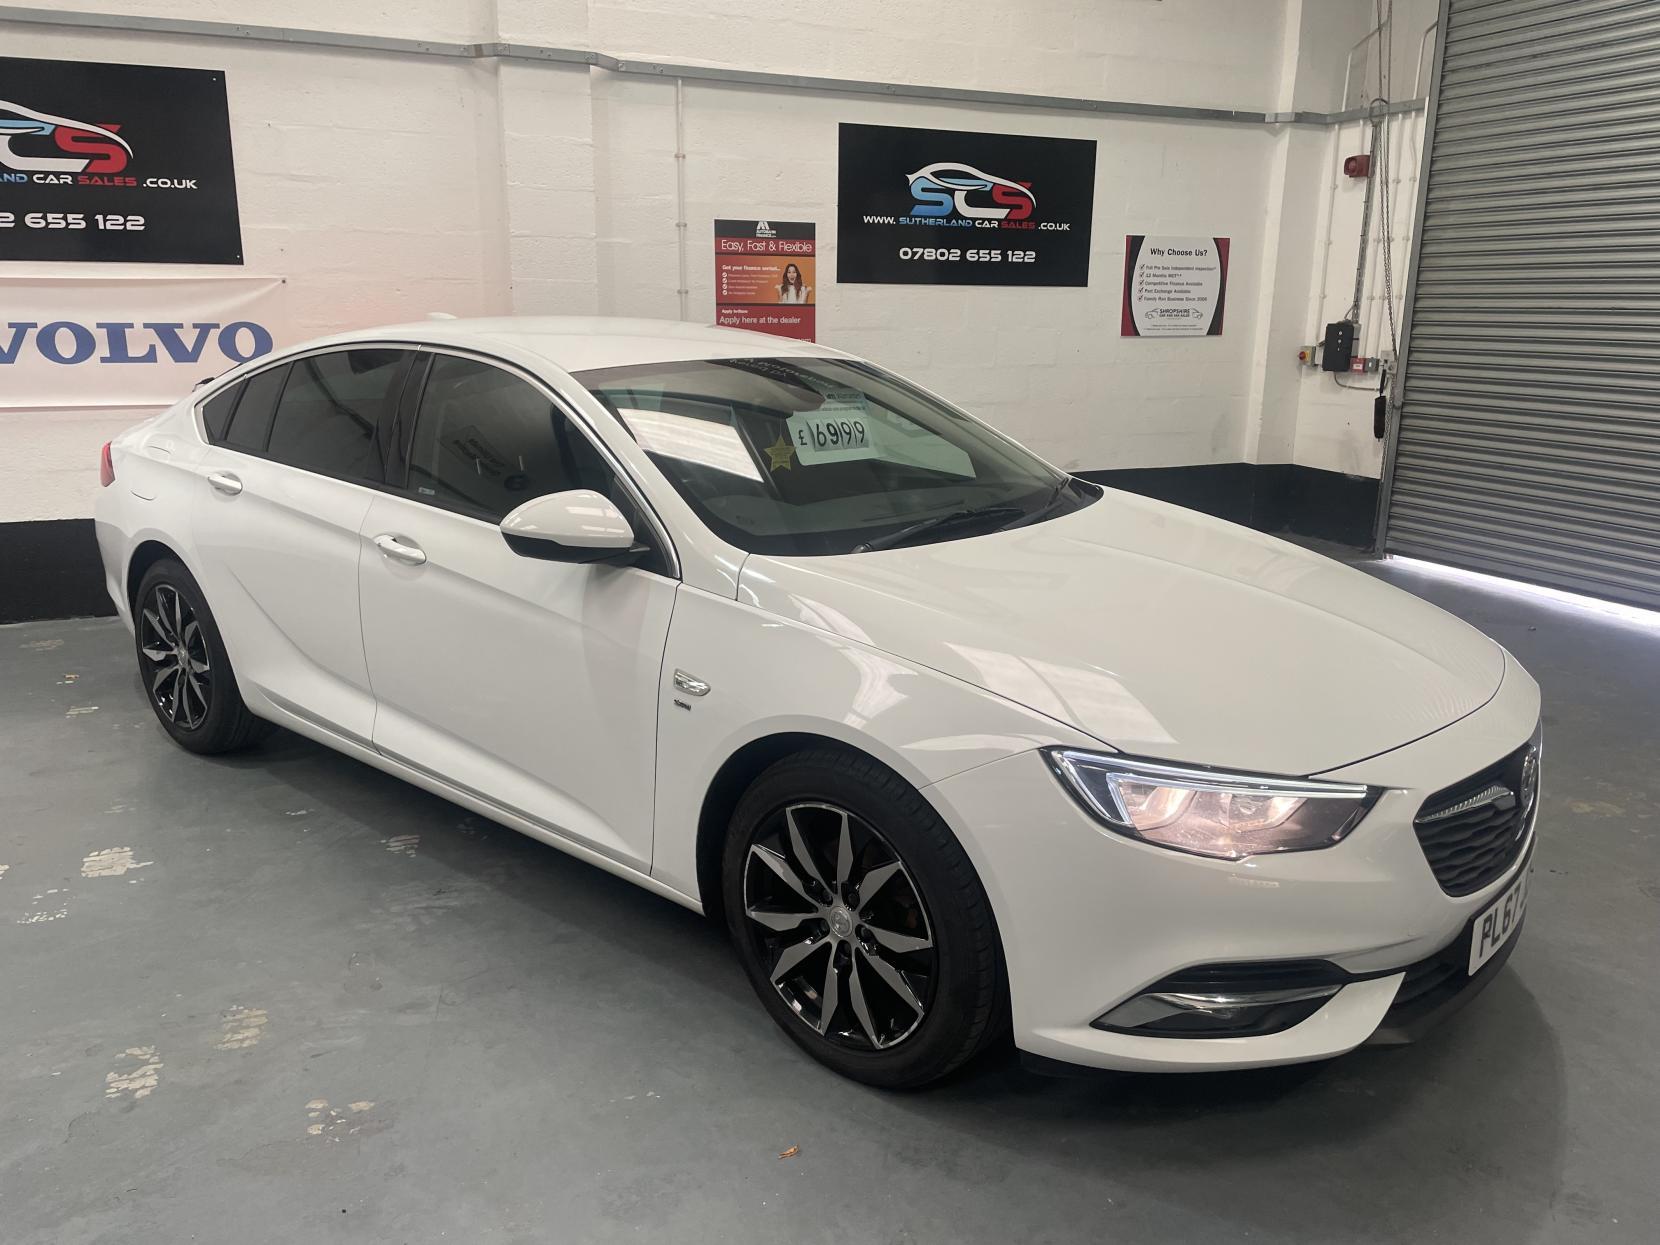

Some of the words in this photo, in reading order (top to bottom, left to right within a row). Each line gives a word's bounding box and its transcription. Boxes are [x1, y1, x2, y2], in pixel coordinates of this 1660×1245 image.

[33, 174, 73, 184] CAR
[78, 175, 137, 187] SALES
[142, 178, 198, 189] .CO.UK
[24, 212, 87, 229] 655
[95, 213, 146, 231] 122
[863, 215, 896, 225] WWW.
[899, 217, 973, 227] SUTHERLAND
[975, 219, 999, 228] CAR
[1000, 220, 1036, 230] SALES
[1038, 221, 1071, 231] .CO.UK
[721, 239, 744, 253] Easy,
[747, 240, 767, 251] Fast
[768, 241, 776, 251] &
[779, 241, 813, 252] Flexible
[1150, 248, 1165, 257] Why
[1167, 248, 1193, 256] Choose
[899, 247, 961, 261] 07802
[966, 249, 1002, 262] 655
[1006, 250, 1036, 263] 122
[719, 315, 740, 325] Apply
[742, 316, 757, 324] here
[767, 316, 778, 324] the
[780, 316, 801, 324] dealer
